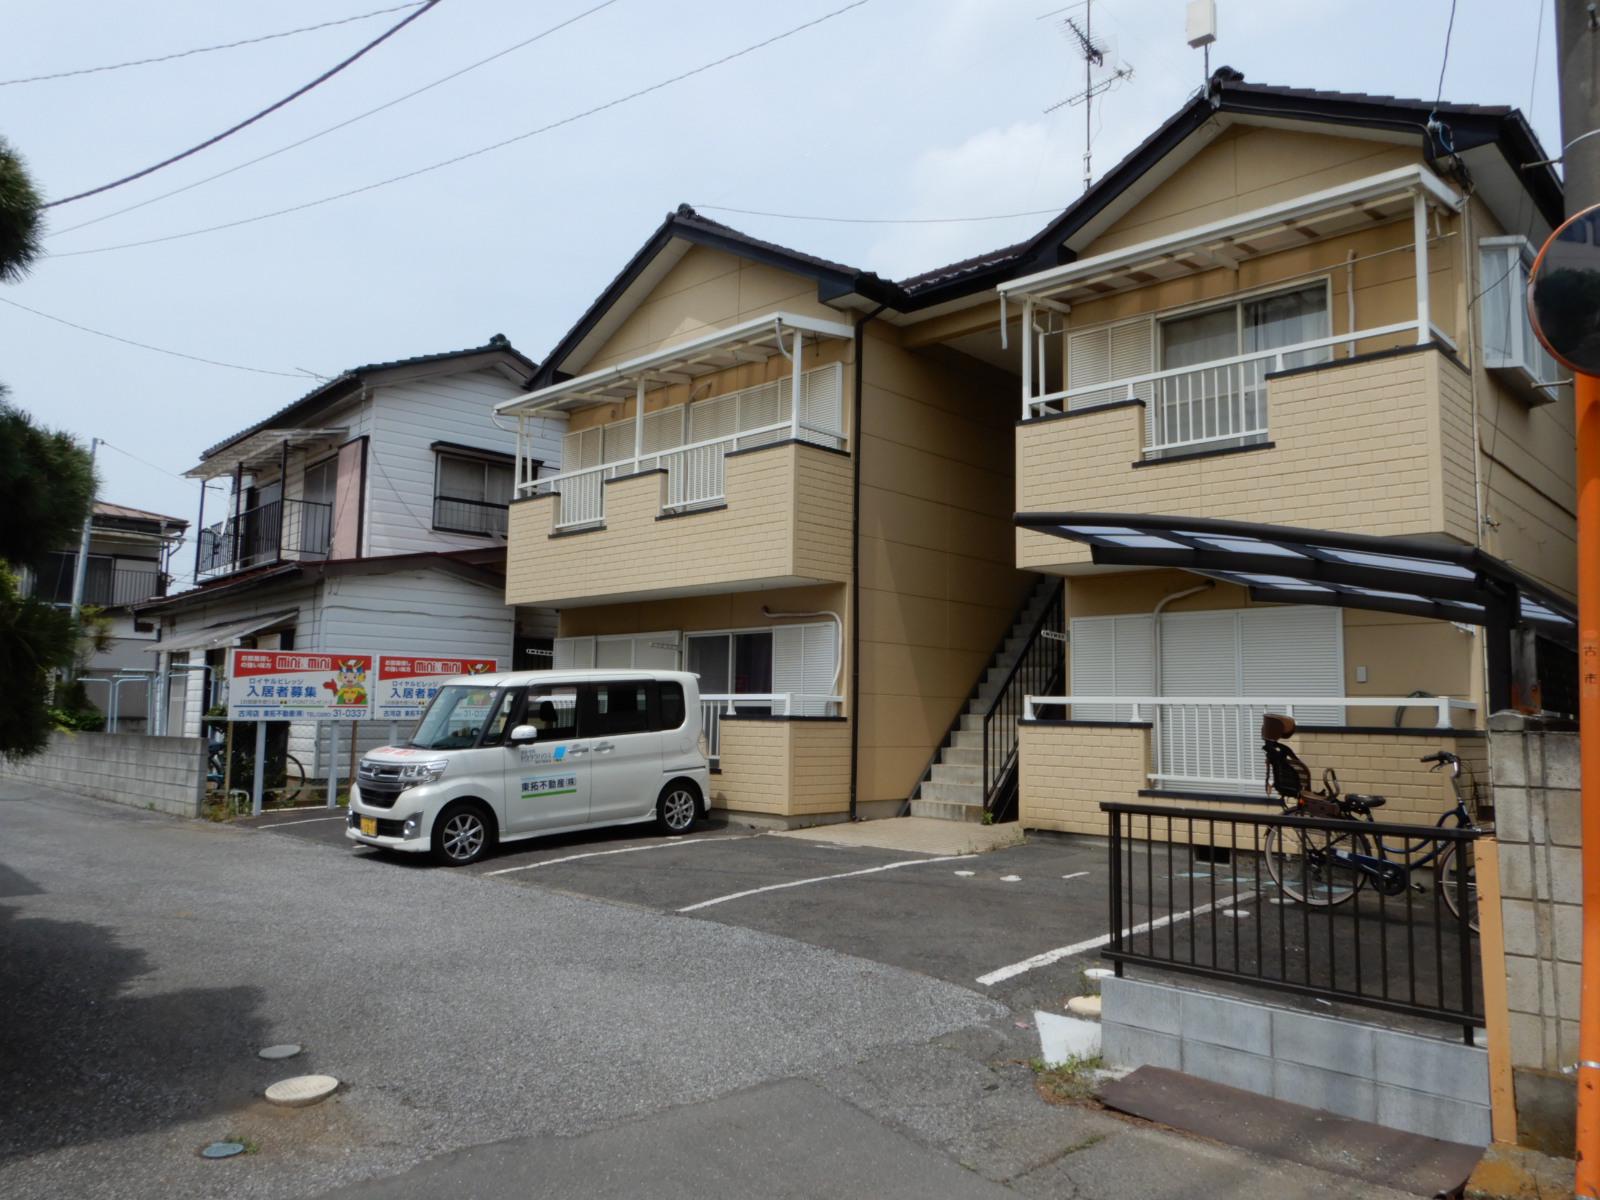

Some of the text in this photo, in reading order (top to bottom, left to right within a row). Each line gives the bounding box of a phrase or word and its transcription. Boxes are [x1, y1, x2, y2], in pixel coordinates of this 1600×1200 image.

[247, 686, 317, 698] 入居者募集
[390, 688, 438, 699] 入居者募
[333, 709, 367, 718] 31-0337
